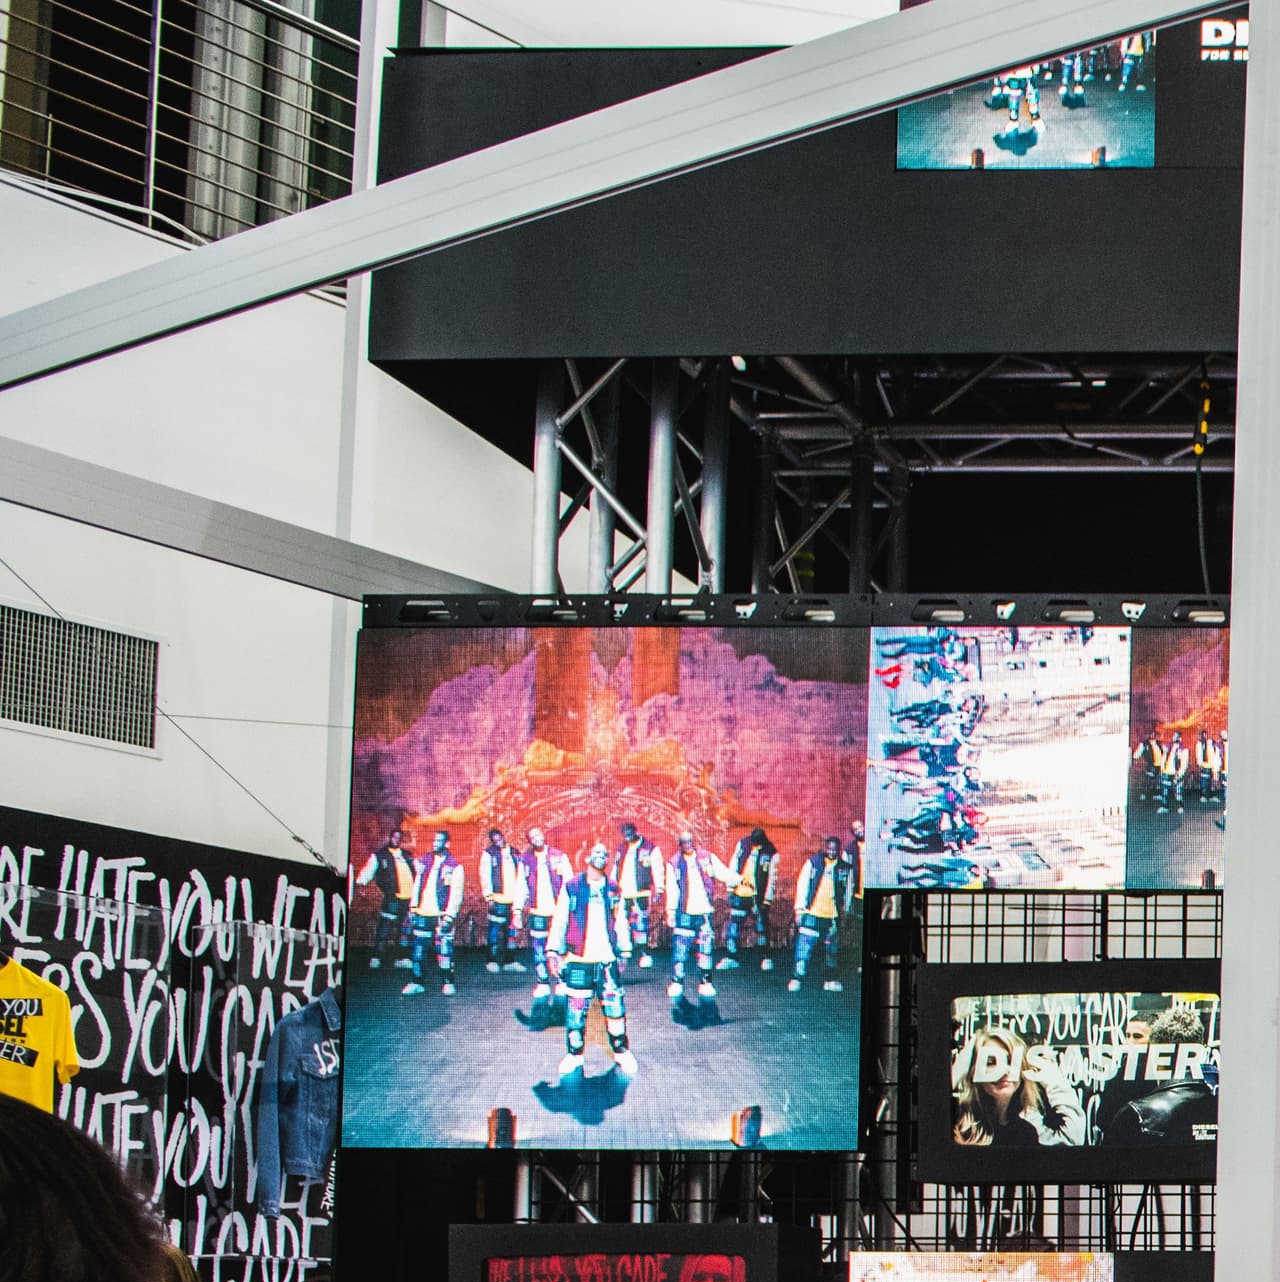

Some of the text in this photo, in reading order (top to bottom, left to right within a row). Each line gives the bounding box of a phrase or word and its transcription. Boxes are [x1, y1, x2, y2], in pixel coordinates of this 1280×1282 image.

[54, 844, 156, 971] HATE
[157, 868, 237, 971] YOU
[122, 965, 213, 1084] YOU
[973, 1044, 1209, 1082] DISASTER
